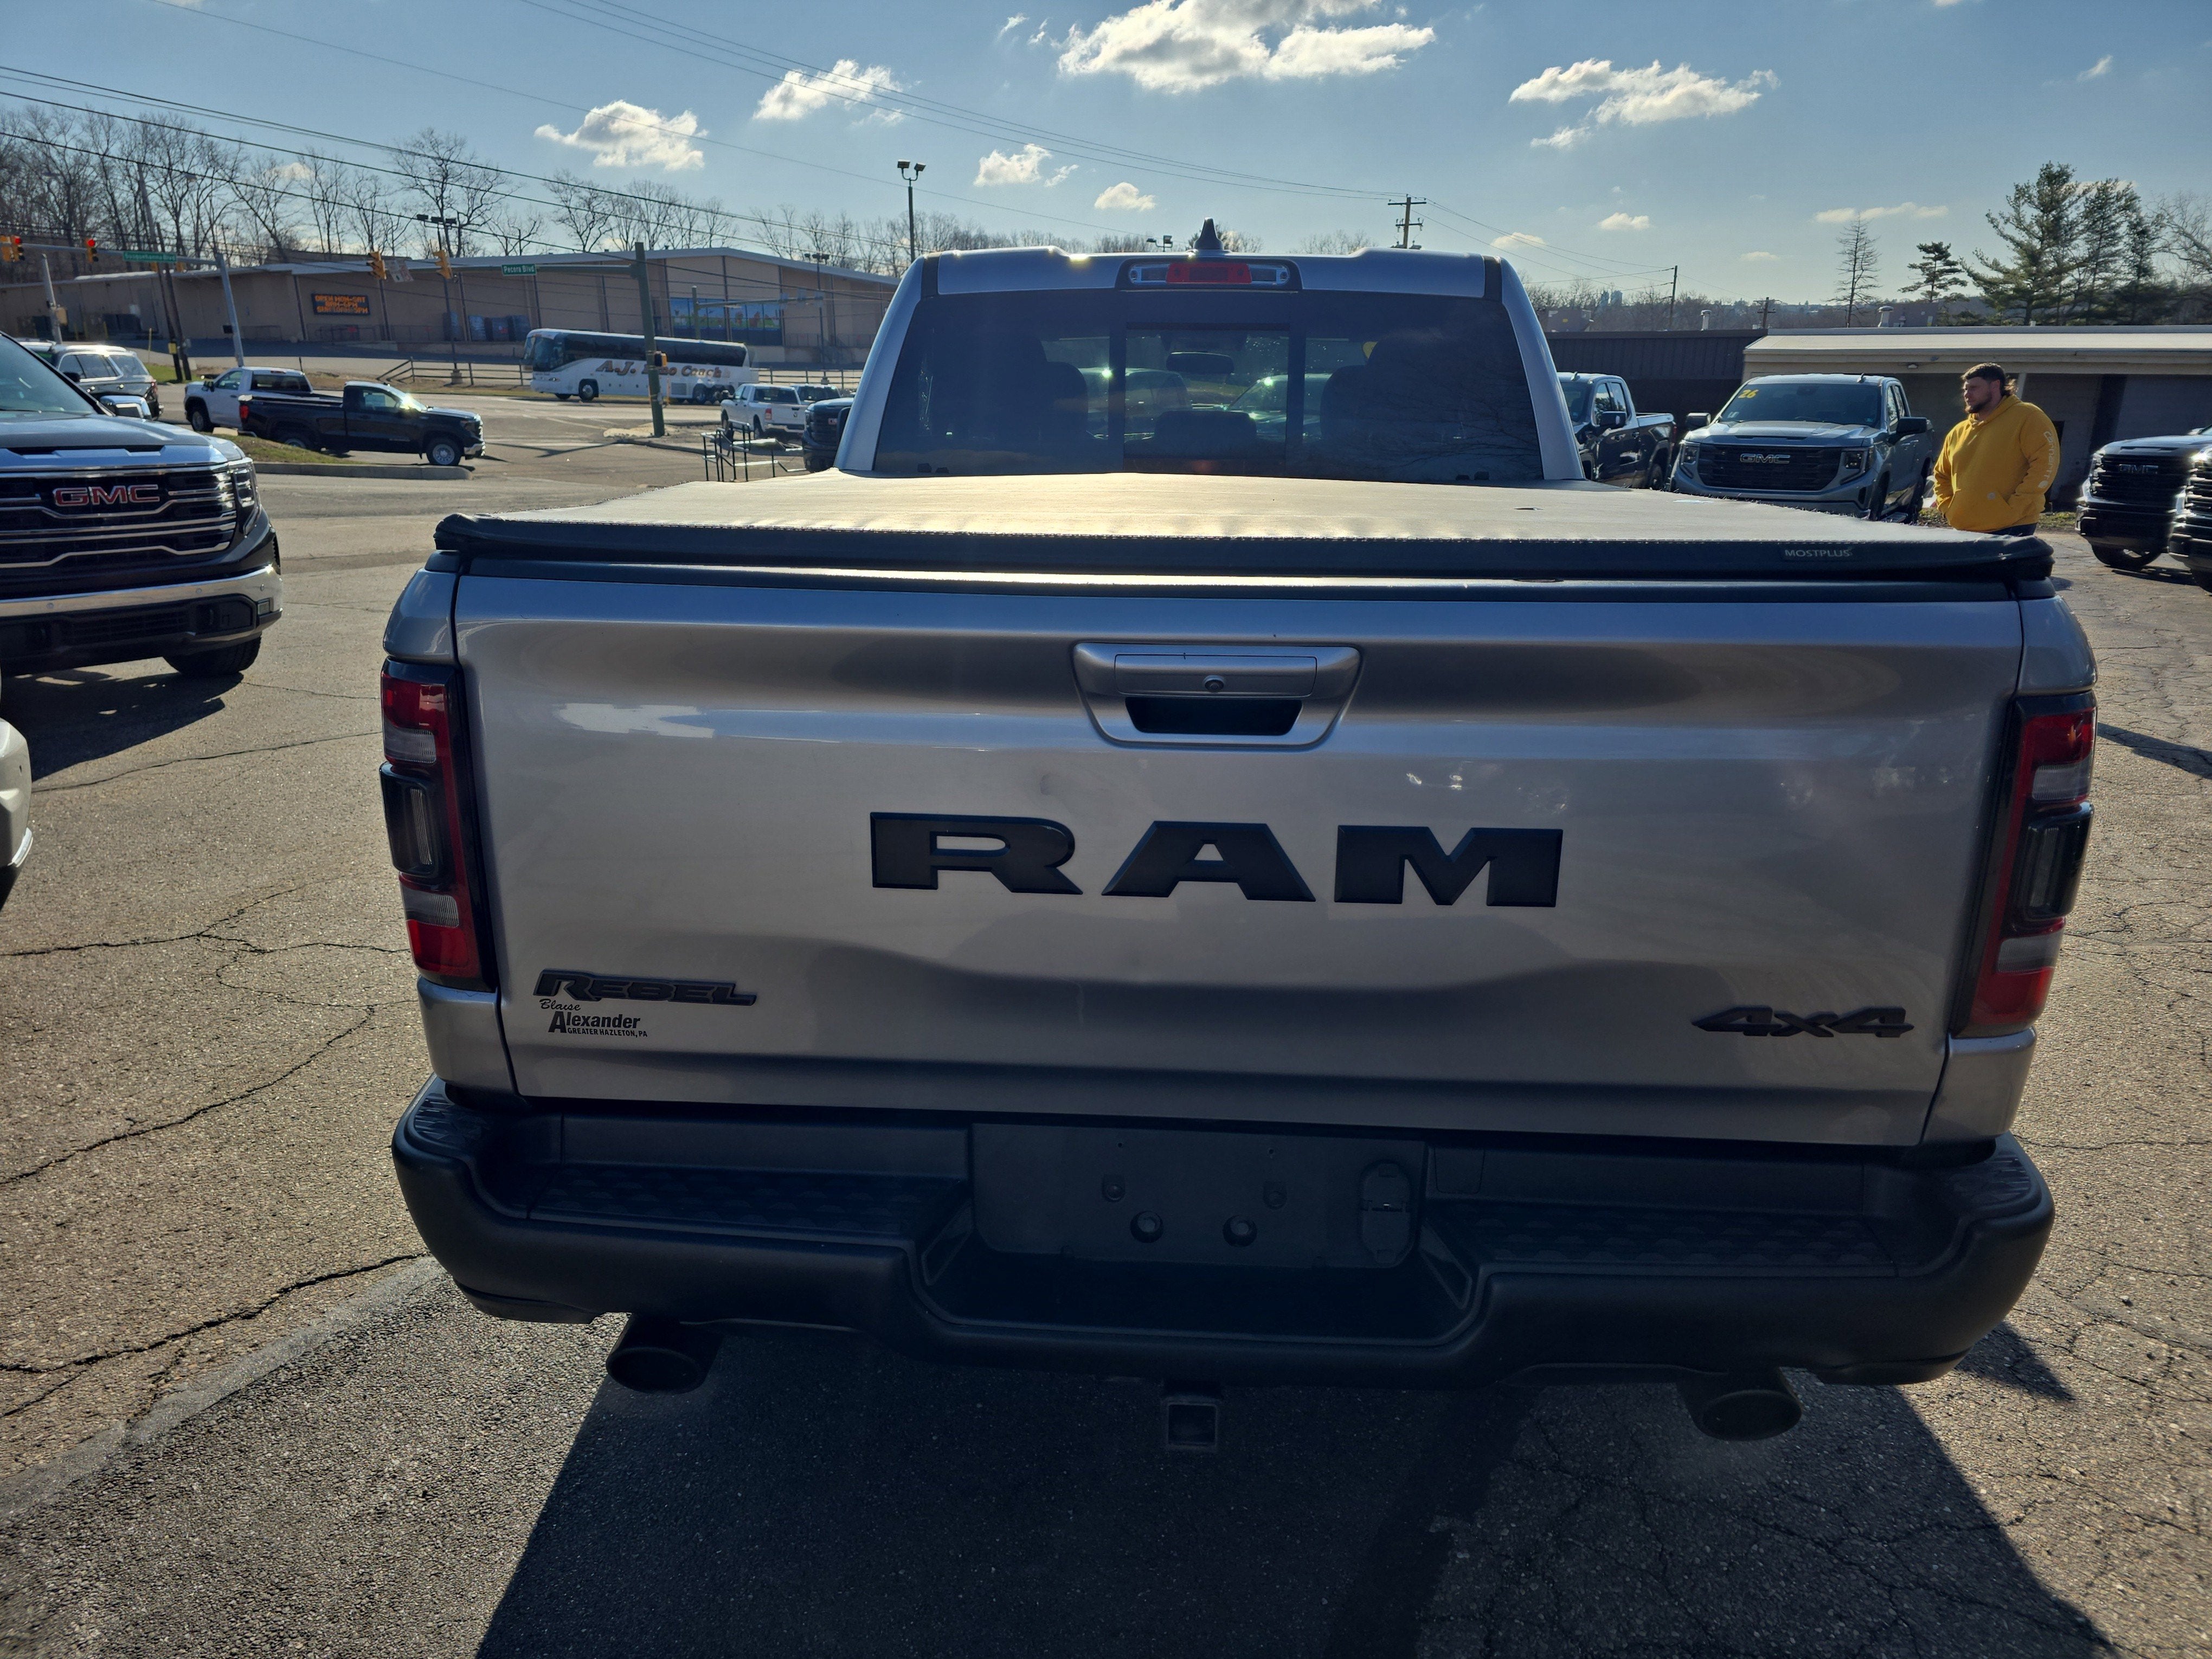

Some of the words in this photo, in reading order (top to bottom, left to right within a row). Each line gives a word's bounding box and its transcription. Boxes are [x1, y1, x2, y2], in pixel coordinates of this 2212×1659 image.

[596, 360, 636, 376] A.J.
[1738, 389, 1759, 398] 26
[1740, 453, 1790, 464] GMC
[53, 484, 160, 507] GMC
[870, 812, 1564, 908] RAM
[539, 998, 581, 1011] Blaise
[548, 1011, 641, 1033] Alexander
[1691, 1005, 1915, 1038] 4x4
[567, 1027, 598, 1036] GREATER
[600, 1028, 638, 1038] HAZLETON,
